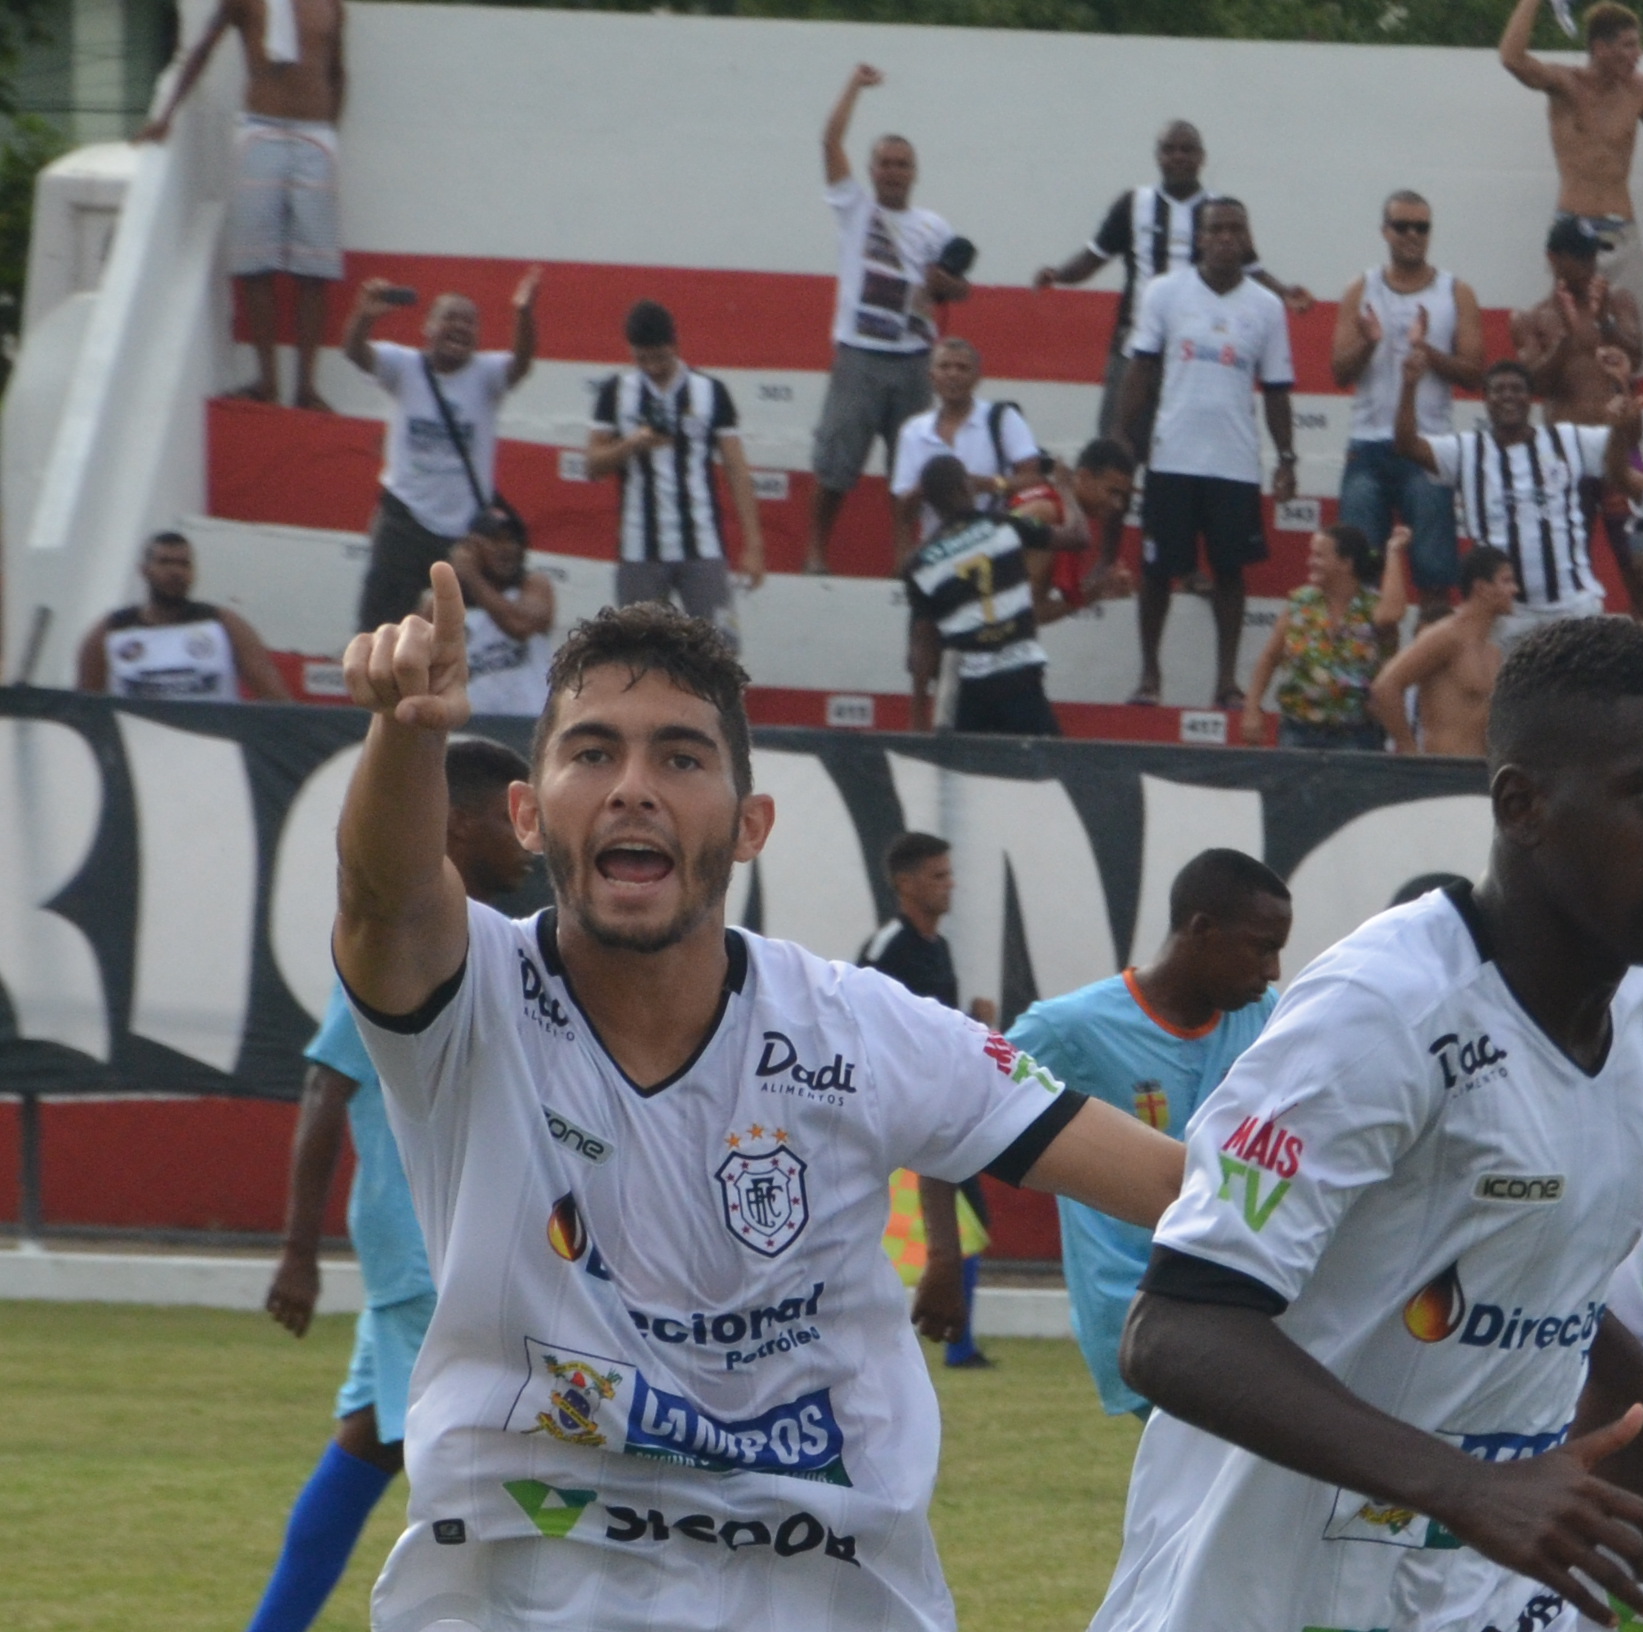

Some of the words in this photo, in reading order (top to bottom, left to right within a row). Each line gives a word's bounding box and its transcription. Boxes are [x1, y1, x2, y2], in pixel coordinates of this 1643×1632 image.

[755, 1031, 857, 1093] Dadi
[760, 1082, 845, 1107] ALIMENTOS
[545, 1108, 605, 1160] one
[1220, 1114, 1303, 1179] MAIS
[1218, 1154, 1292, 1233] TV
